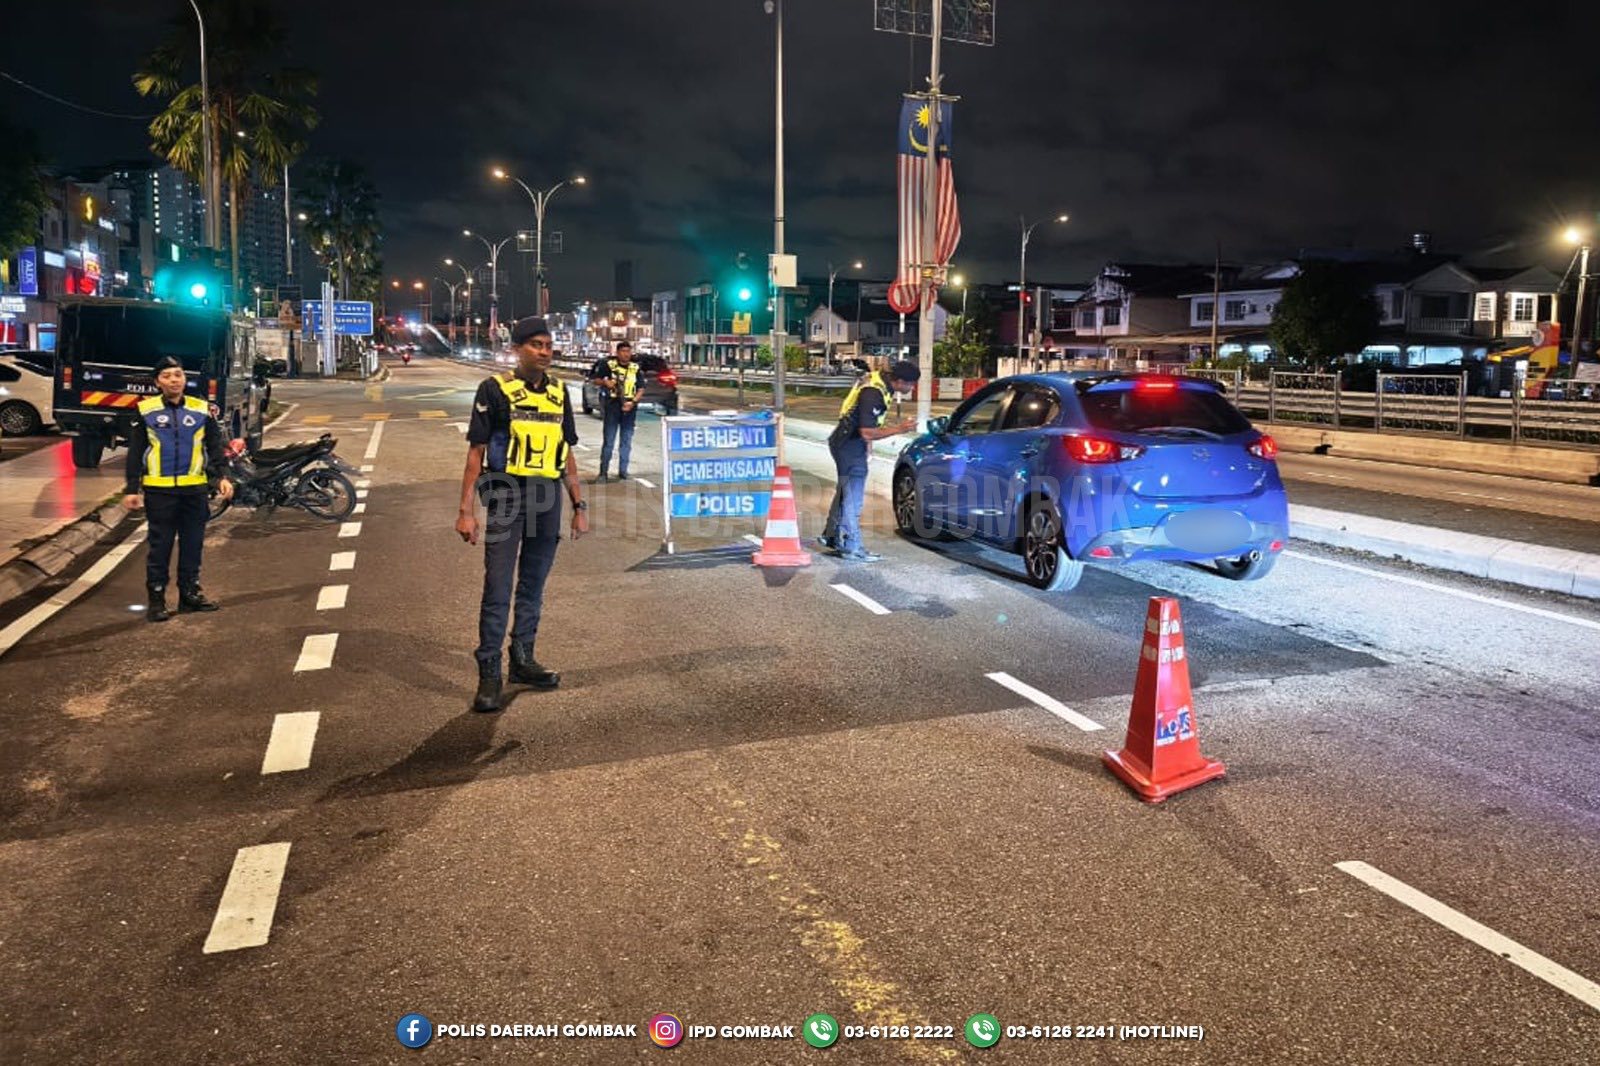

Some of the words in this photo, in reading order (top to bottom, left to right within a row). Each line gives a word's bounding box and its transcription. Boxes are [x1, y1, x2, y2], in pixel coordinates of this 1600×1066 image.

[680, 427, 767, 448] BERHENTI
[673, 459, 775, 481] PEMERIKSAAN
[697, 495, 755, 514] POLIS
